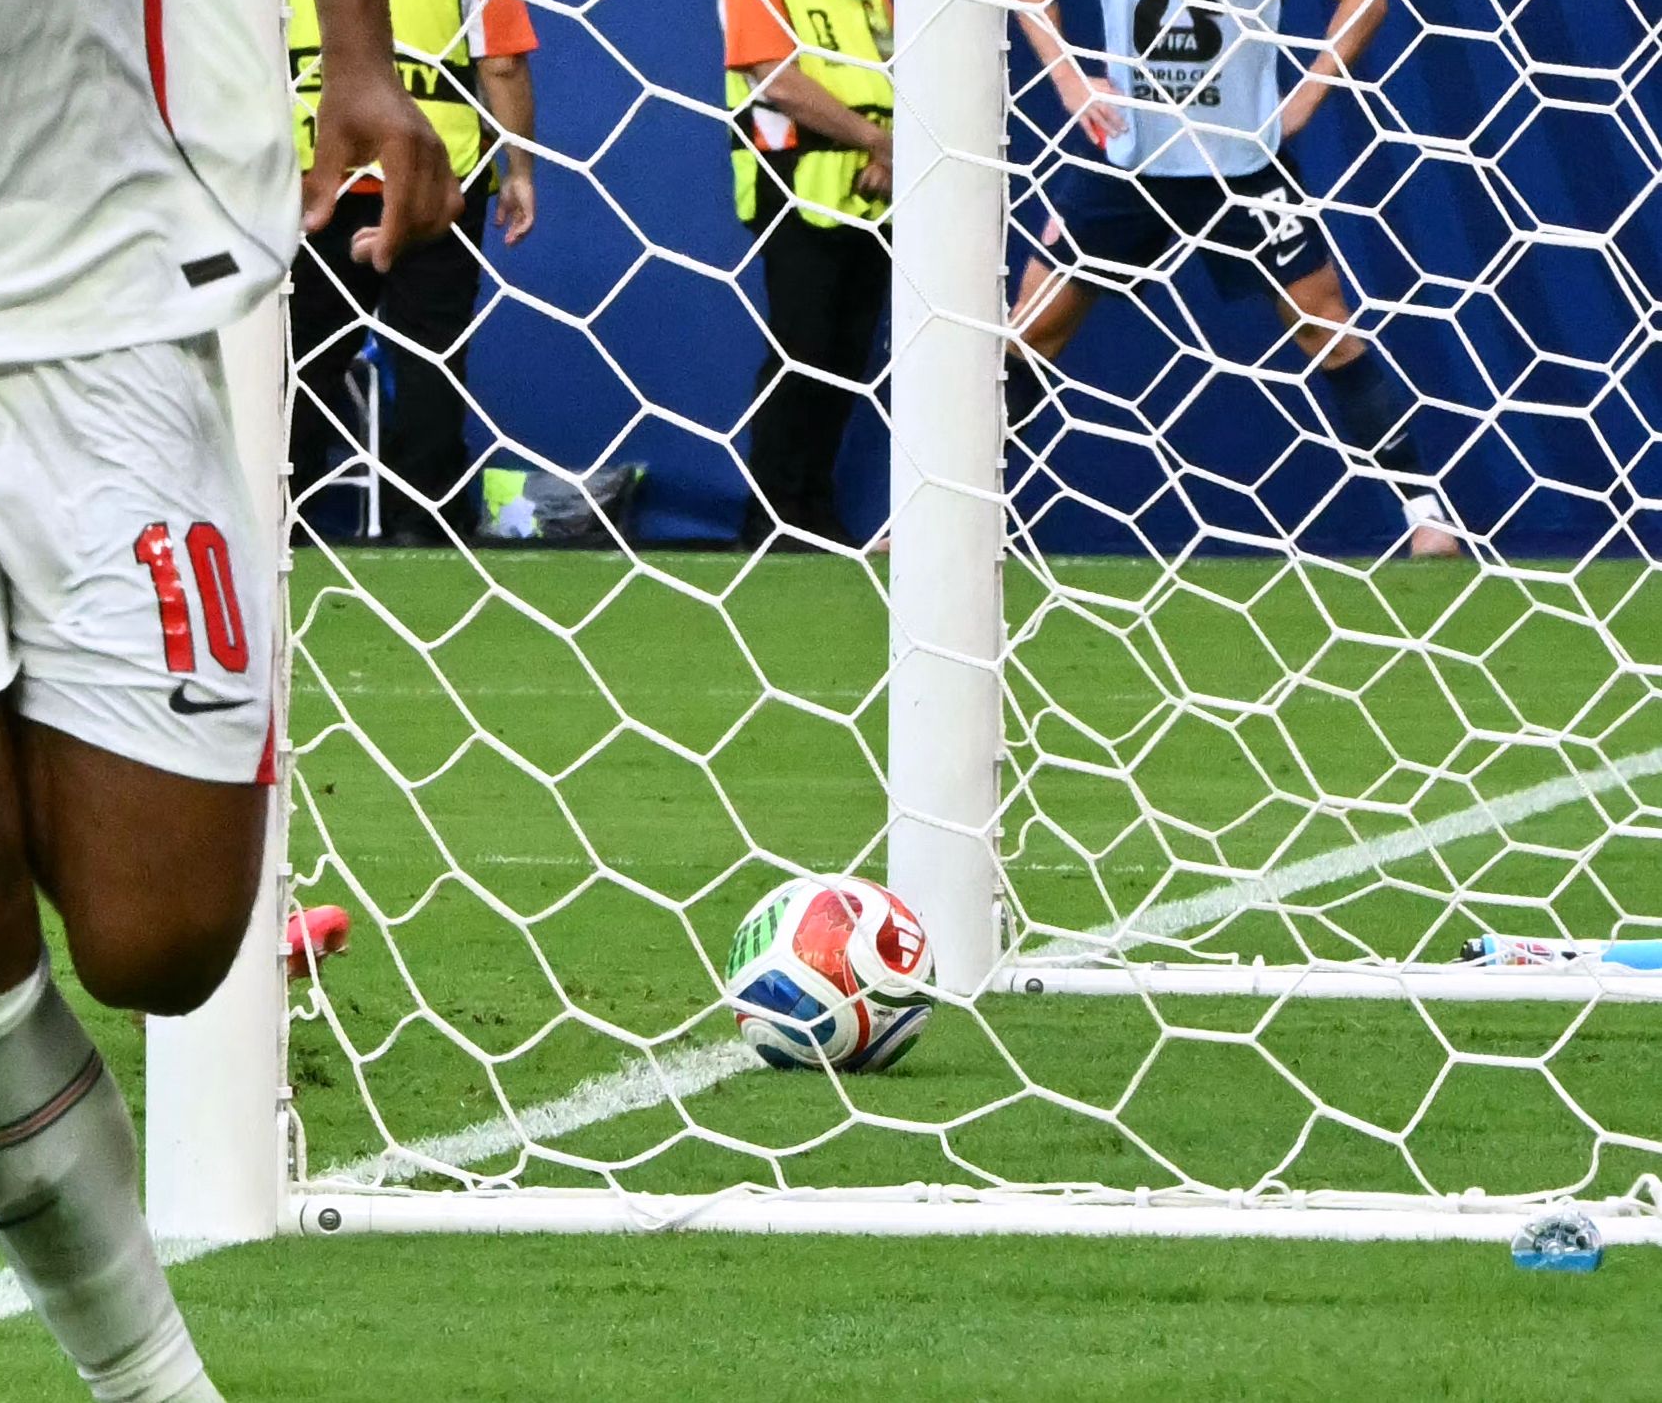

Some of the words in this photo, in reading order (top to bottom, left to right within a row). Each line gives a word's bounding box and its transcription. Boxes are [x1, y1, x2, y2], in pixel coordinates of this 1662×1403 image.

[296, 54, 440, 95] STY
[1133, 69, 1186, 81] WORLD
[1133, 84, 1221, 106] 2026
[134, 520, 249, 674] 10
